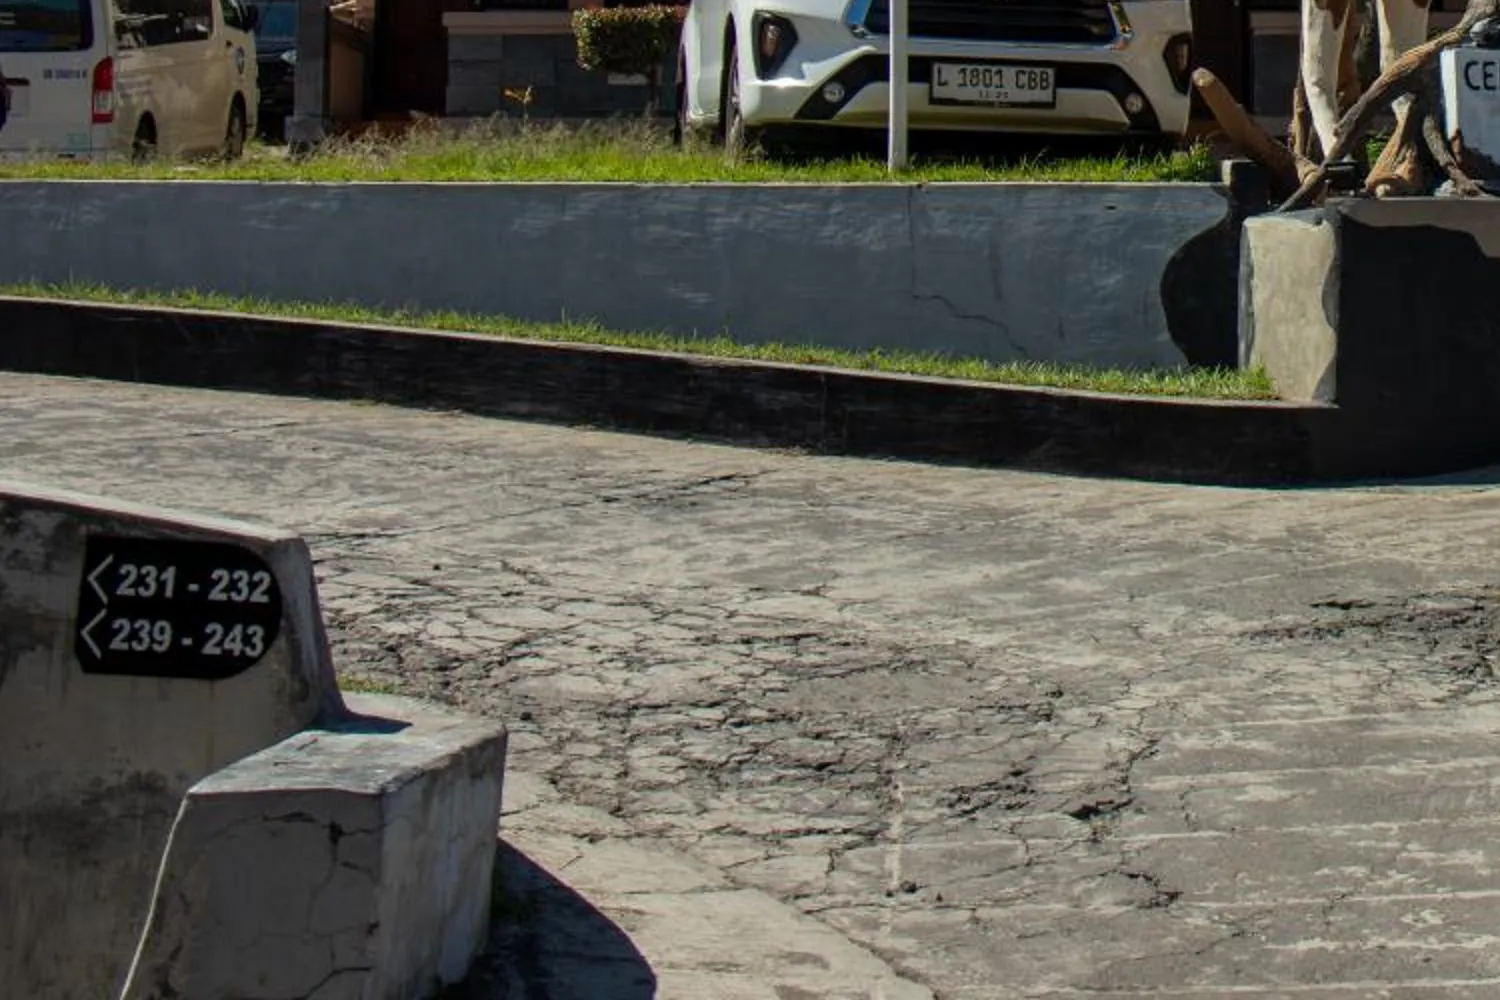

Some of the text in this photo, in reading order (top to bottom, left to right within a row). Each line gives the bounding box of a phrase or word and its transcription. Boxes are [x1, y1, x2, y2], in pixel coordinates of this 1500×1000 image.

[937, 67, 1050, 91] L 1801 CBB
[116, 564, 177, 598] 231
[208, 568, 271, 603] 232
[109, 618, 173, 653] 239
[201, 622, 265, 658] 243
